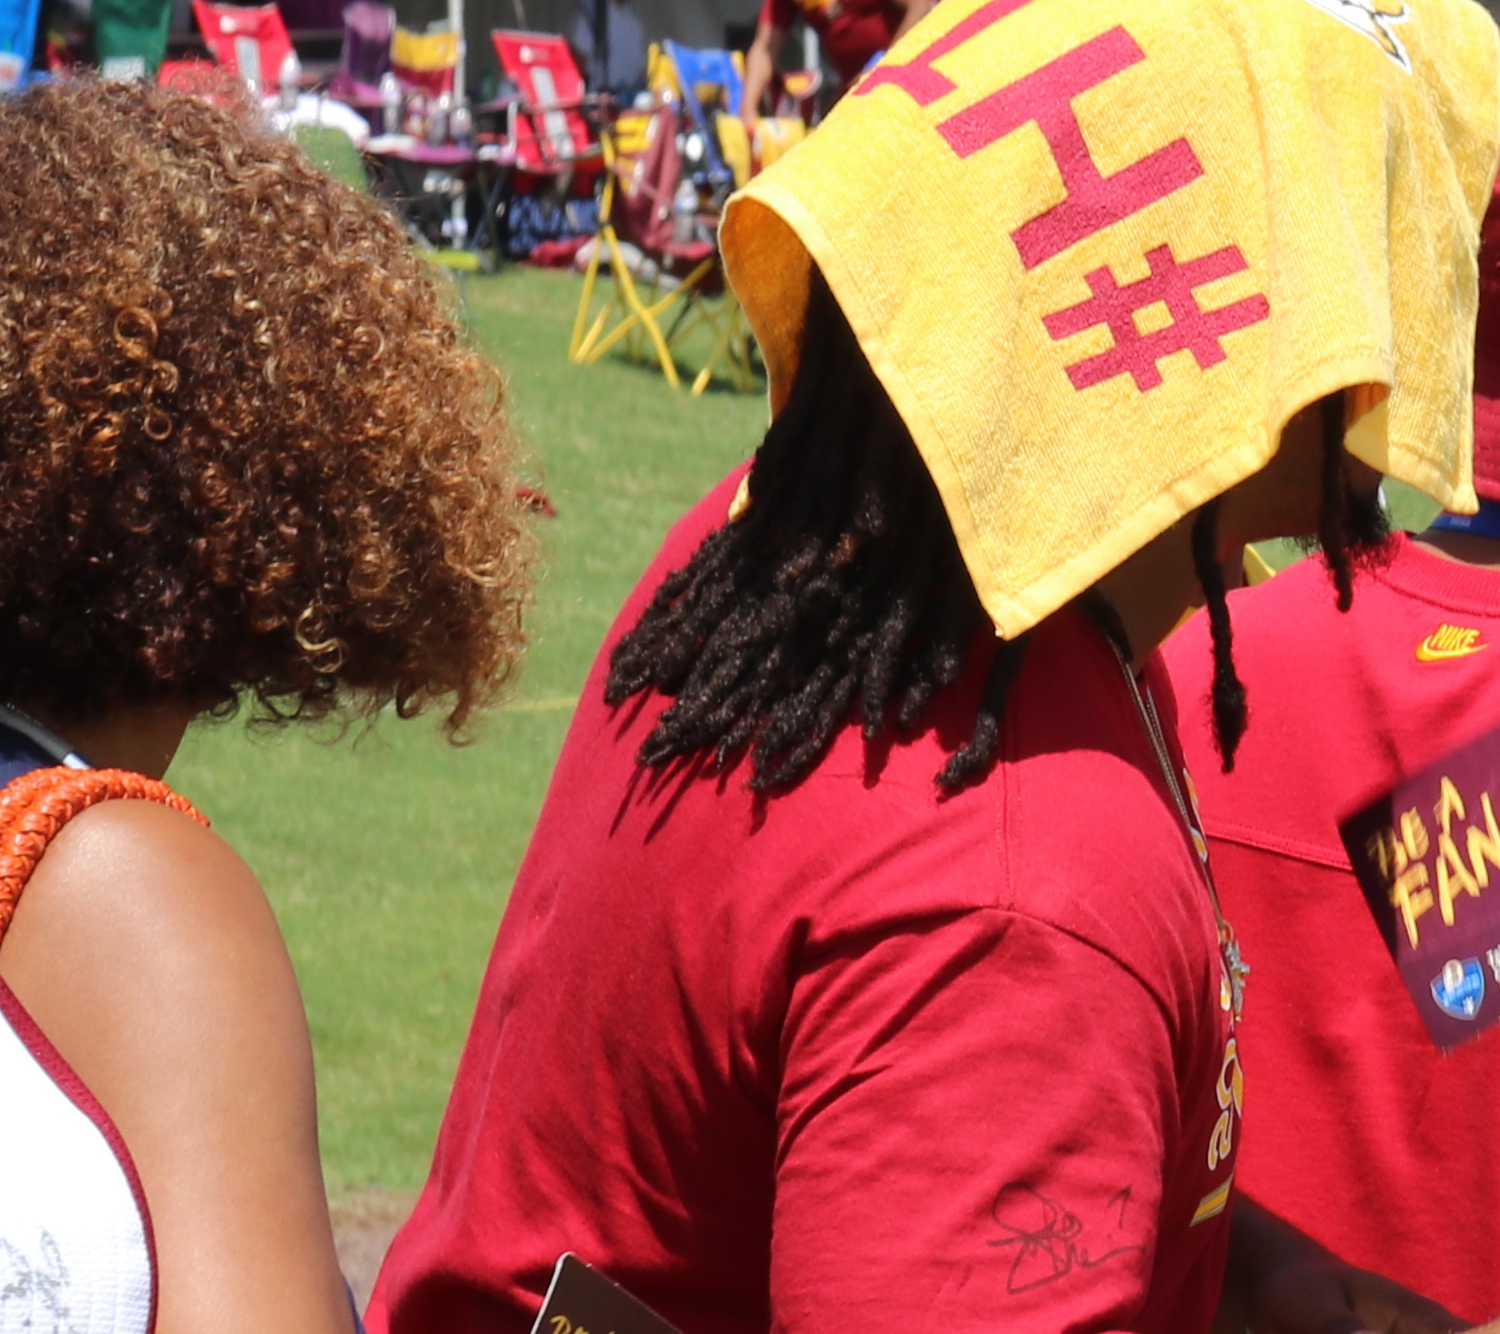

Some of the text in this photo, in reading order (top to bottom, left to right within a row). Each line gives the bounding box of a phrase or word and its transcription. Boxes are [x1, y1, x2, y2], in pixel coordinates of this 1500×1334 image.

[1430, 623, 1480, 651] NIKE
[1367, 775, 1465, 877] BE A
